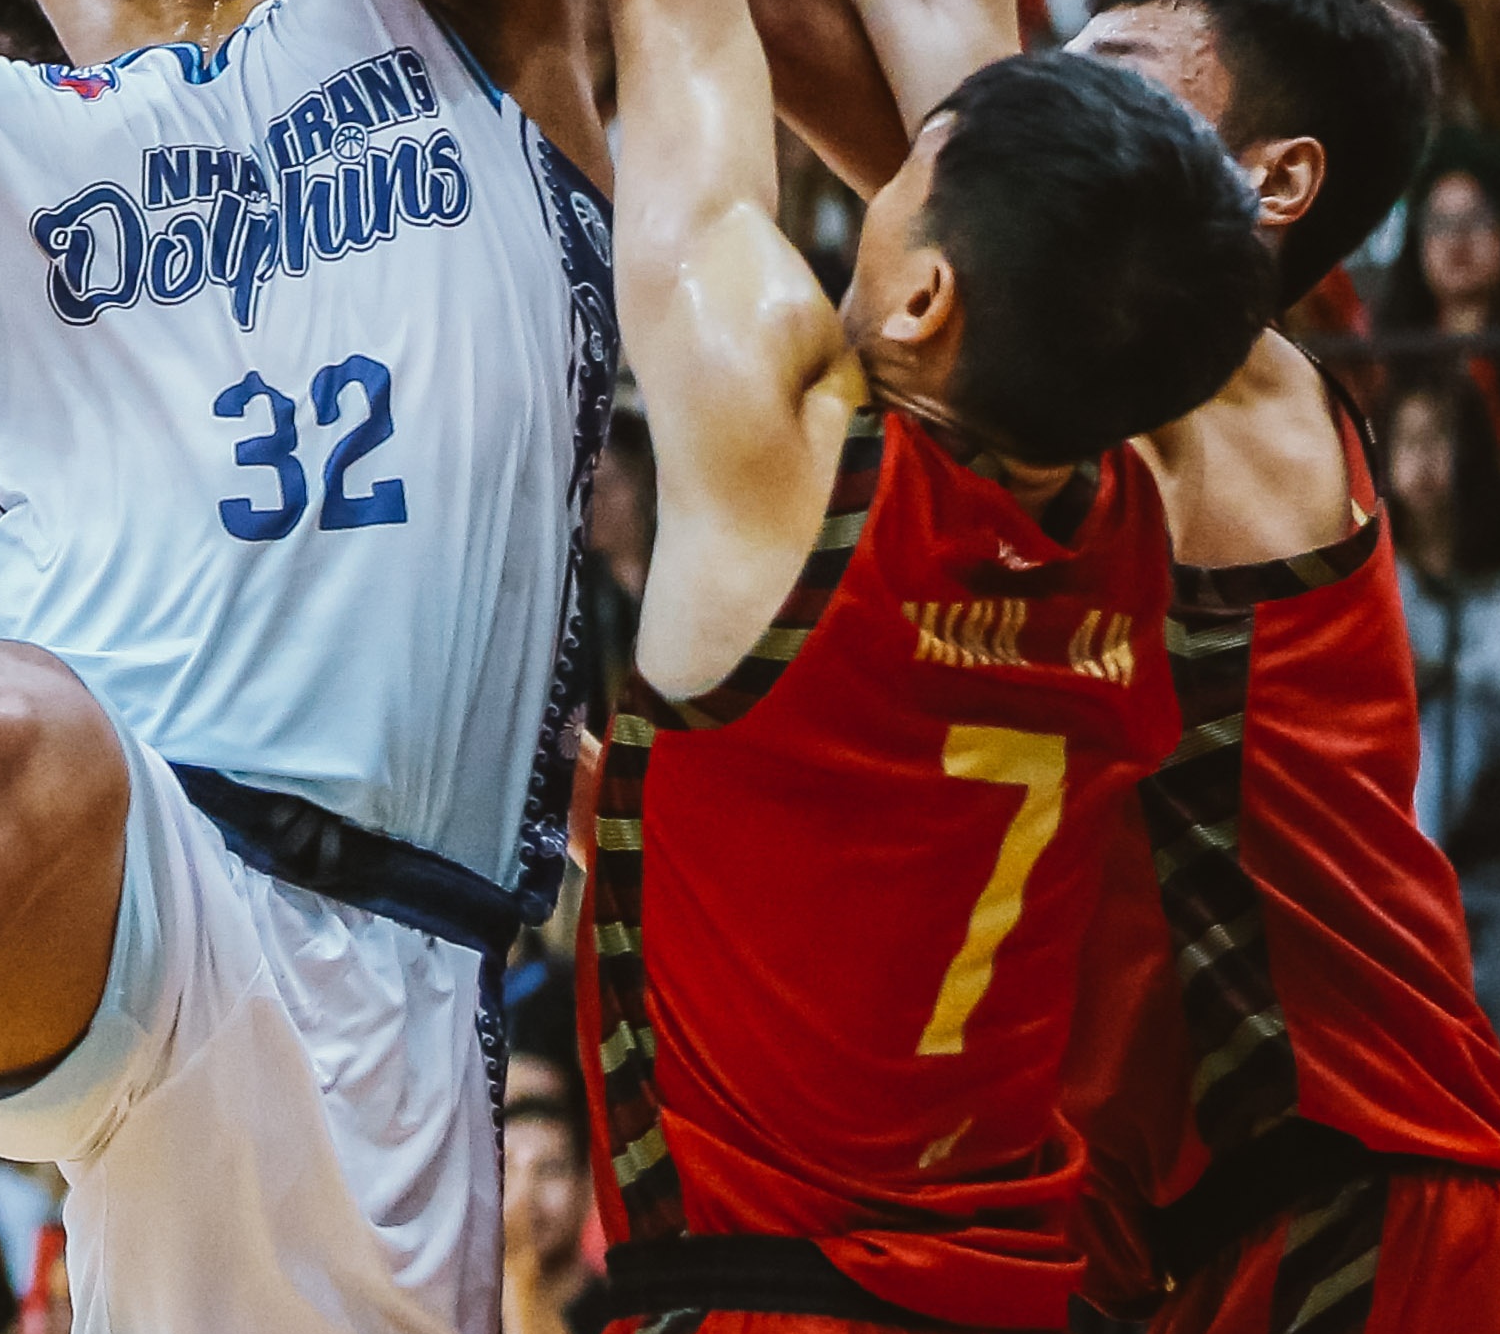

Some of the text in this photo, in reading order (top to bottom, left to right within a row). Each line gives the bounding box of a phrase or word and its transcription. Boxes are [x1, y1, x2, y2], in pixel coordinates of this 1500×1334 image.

[142, 45, 440, 207] NHA TRANG
[30, 125, 472, 331] Dolphins
[212, 351, 410, 543] 32
[914, 724, 1068, 1057] 7
